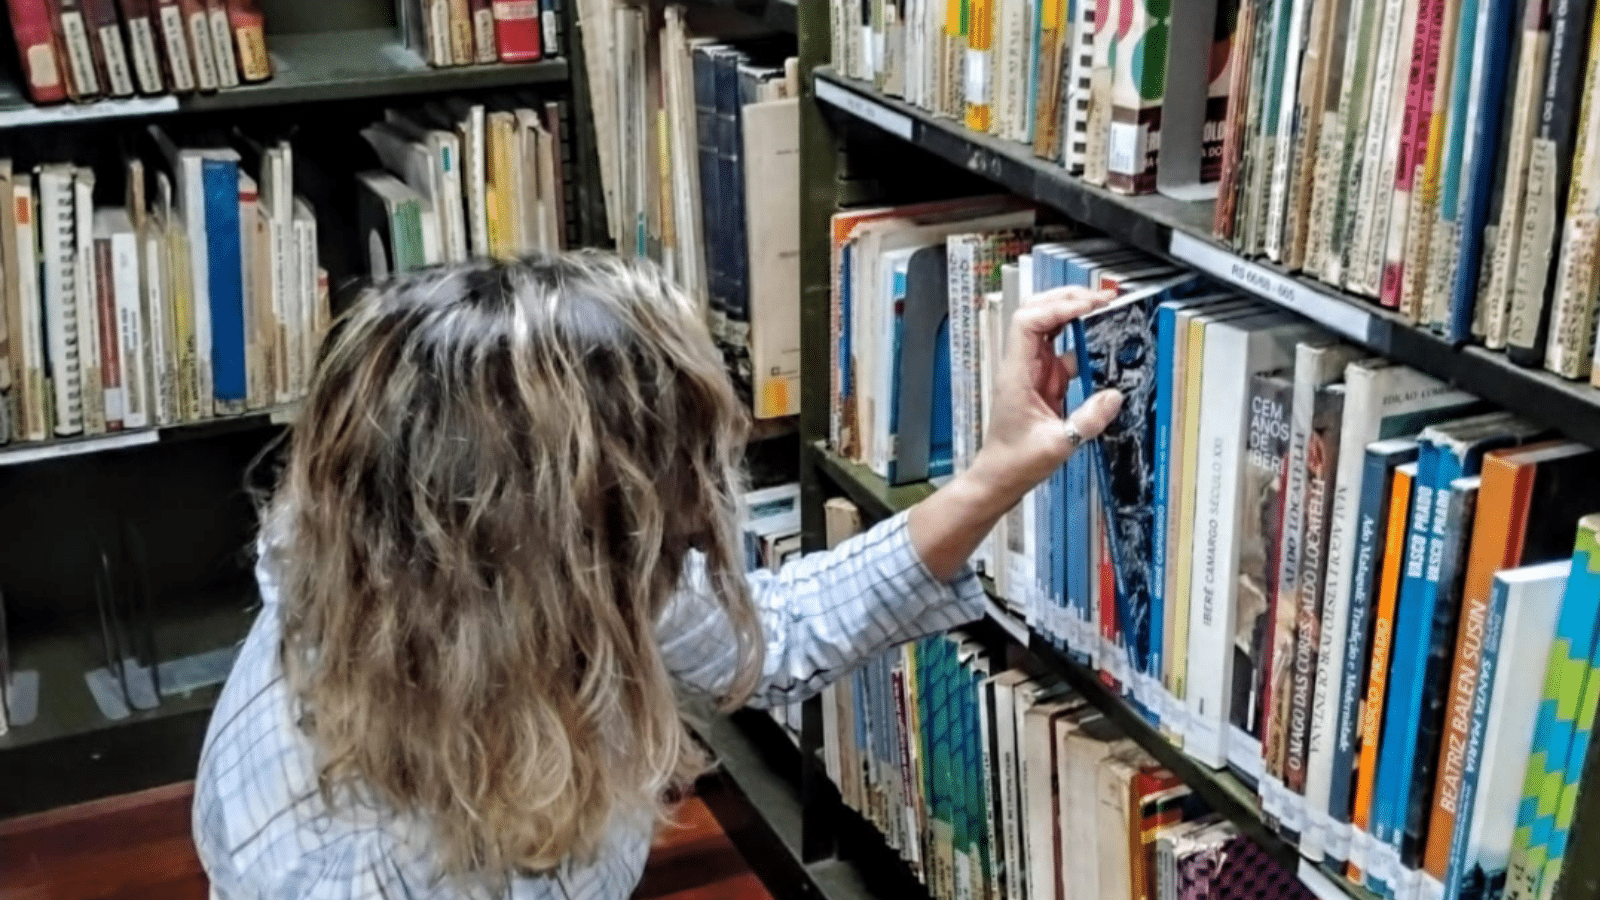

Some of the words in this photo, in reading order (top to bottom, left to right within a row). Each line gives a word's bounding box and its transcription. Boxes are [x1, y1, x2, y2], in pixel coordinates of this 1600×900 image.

[959, 258, 972, 370] QUEERMUSEU
[1250, 415, 1290, 442] ANOS
[1251, 395, 1283, 420] CEM
[1247, 450, 1282, 474] IBER
[1250, 431, 1270, 452] DE
[1288, 432, 1305, 531] LOCATELLI
[1304, 479, 1325, 568] LOCATELLI
[1328, 486, 1348, 577] MALAGOLI
[1360, 513, 1375, 543] Ado
[1413, 485, 1433, 532] PRADO
[1432, 488, 1450, 535] PRADO
[1206, 519, 1219, 584] CAMARGO
[1284, 536, 1297, 586] ALDO
[1407, 533, 1427, 579] VASCO
[1426, 537, 1443, 582] VASCO
[1301, 570, 1318, 615] ALDO
[1323, 580, 1338, 631] VISTO
[1319, 633, 1332, 666] POR
[1348, 606, 1365, 660] Tradição
[1371, 617, 1388, 683] PRADO
[1463, 599, 1487, 666] SUSIN
[1294, 674, 1309, 707] DAS
[1310, 668, 1329, 753] QUINTANA
[1452, 665, 1477, 734] BALEN
[1473, 656, 1491, 715] SANTA
[1290, 708, 1307, 757] MAGO
[1339, 671, 1357, 752] Modernidade
[1363, 686, 1380, 747] VASCO
[1288, 756, 1301, 770] O
[1465, 717, 1482, 773] MARIA
[1440, 731, 1466, 814] BEATRIZ
